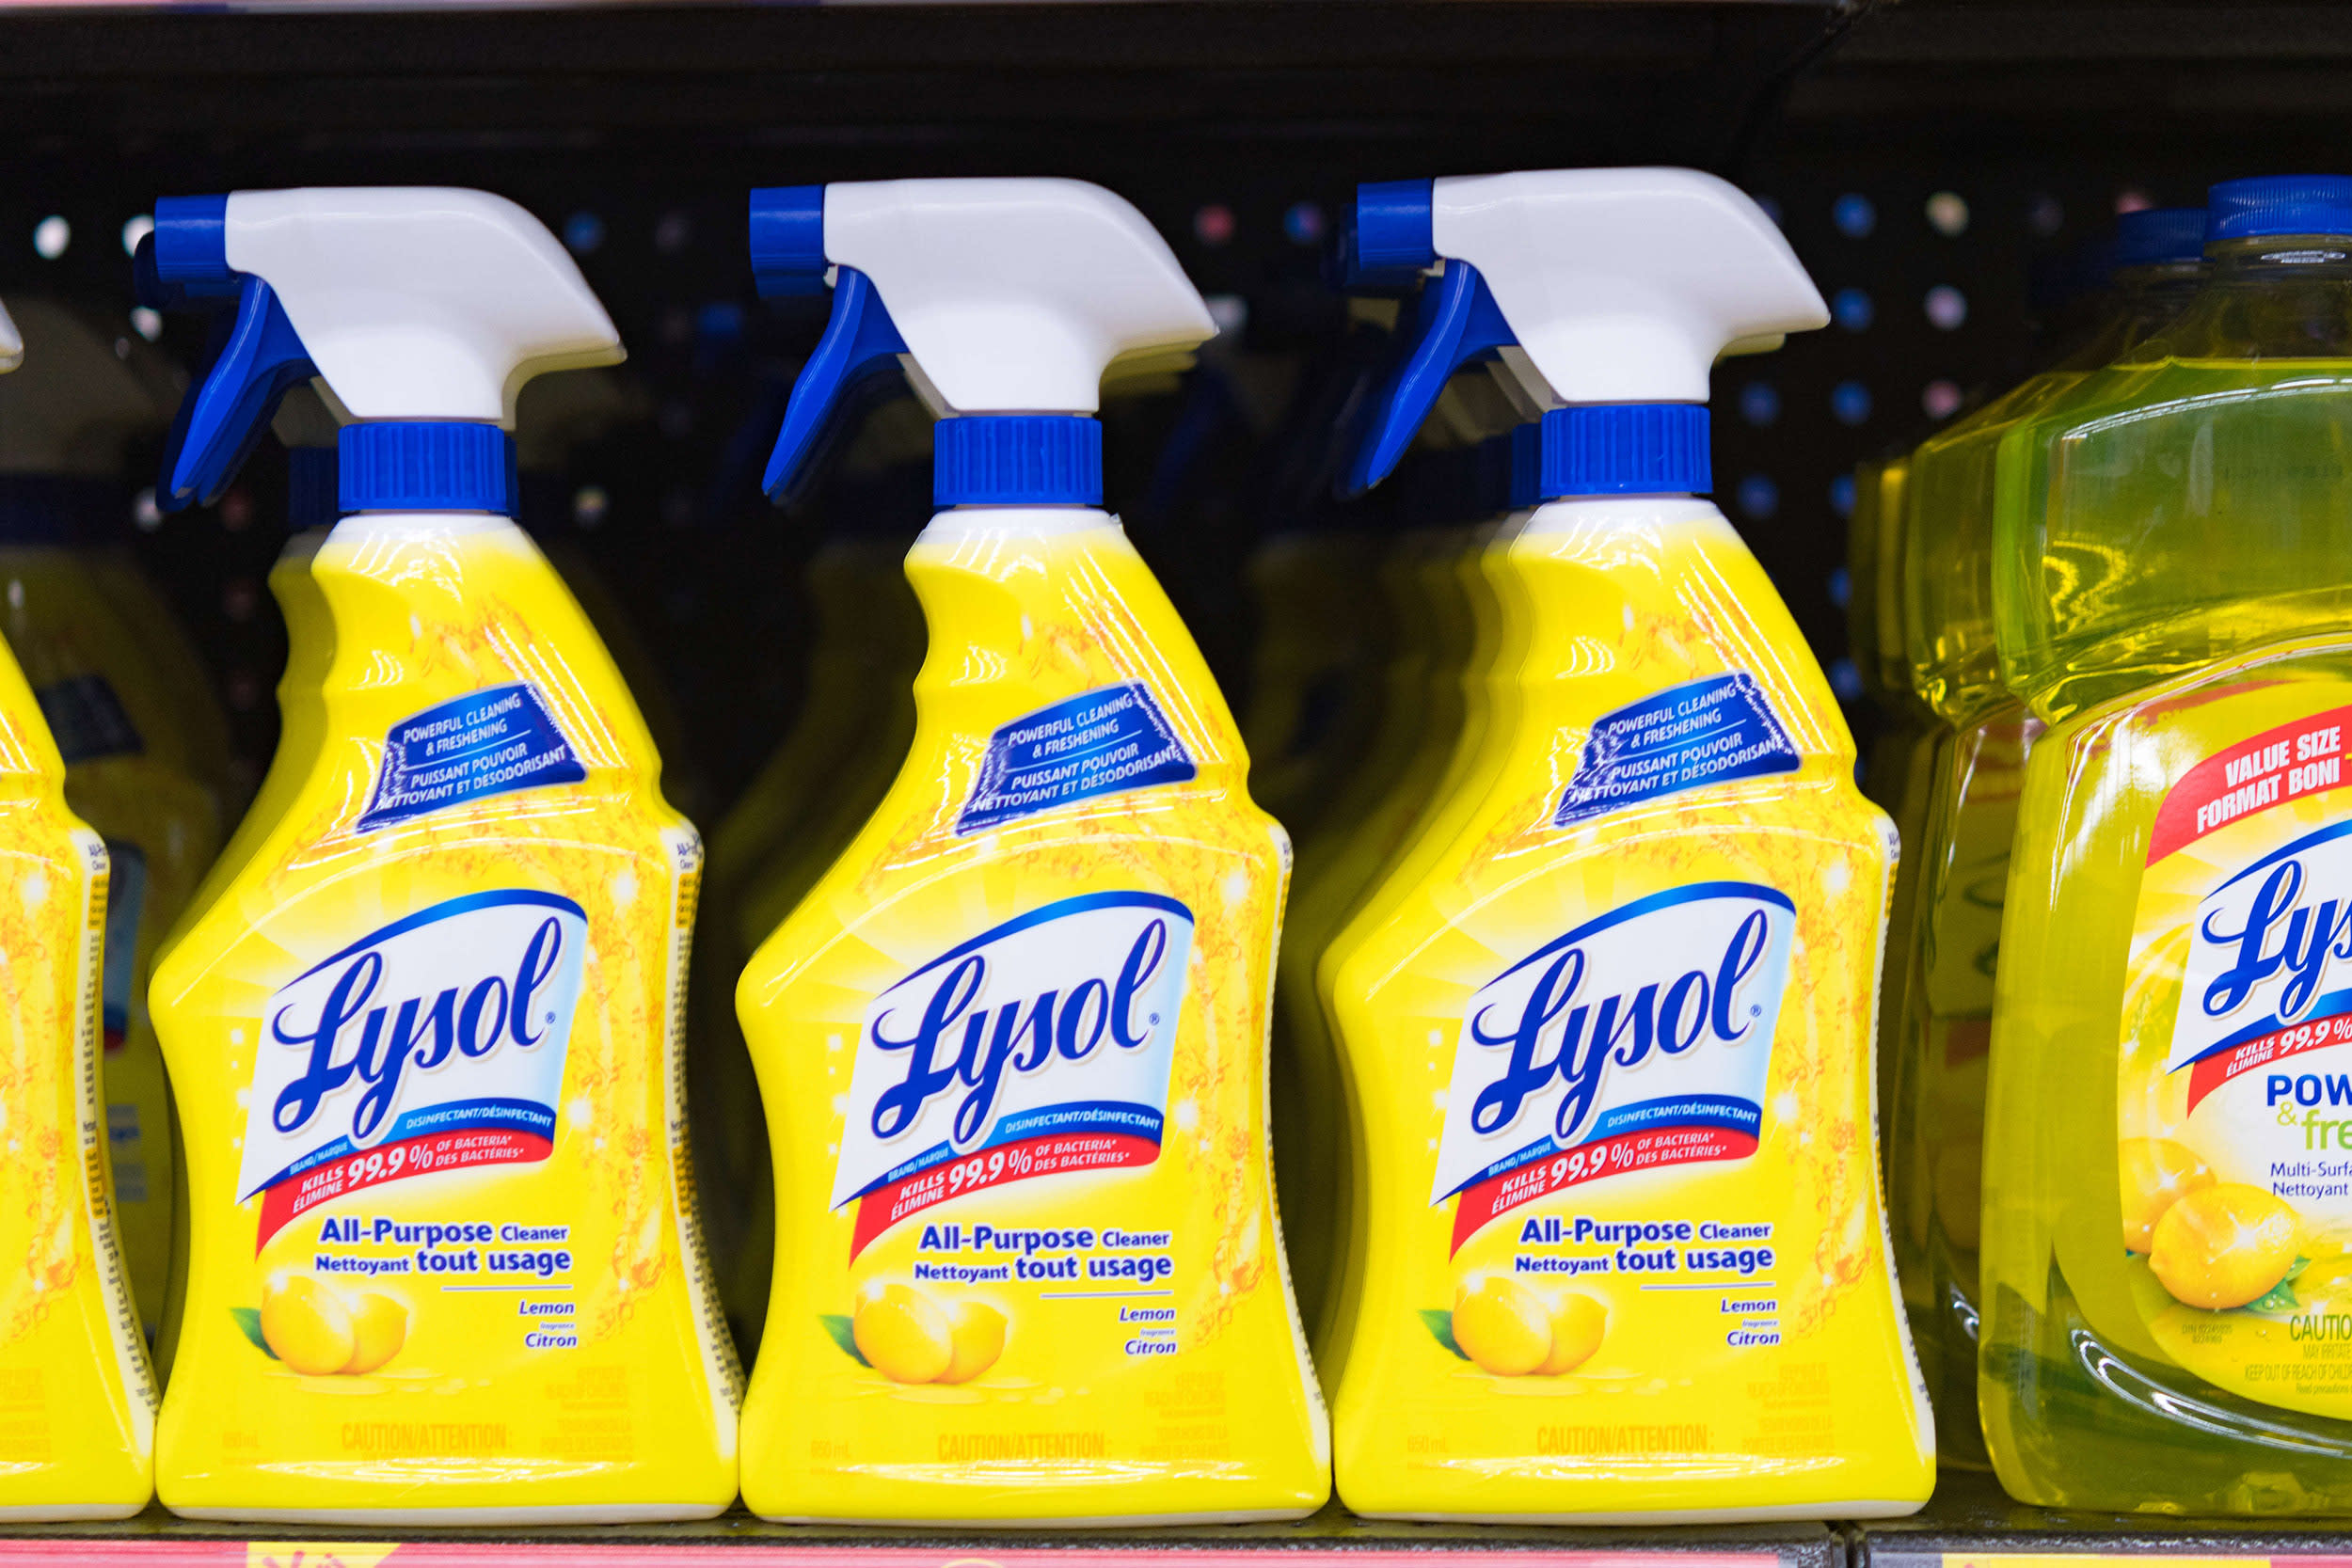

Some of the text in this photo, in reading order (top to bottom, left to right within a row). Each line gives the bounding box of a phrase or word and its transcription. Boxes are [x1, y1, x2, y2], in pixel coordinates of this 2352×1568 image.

[403, 692, 522, 744] POWERFUL CLEANING
[1008, 692, 1133, 747] POWERFUL CLEANING
[1607, 682, 1737, 736] POWERFUL CLEANING
[1630, 707, 1723, 749] & FRESHENING
[425, 718, 508, 756] & FRESHENING
[1032, 718, 1120, 759] & FRESHENING
[1610, 732, 1743, 779] PUISSANT POUVOIR
[2224, 725, 2342, 788] VALUE SIZE
[375, 743, 567, 812] NETTOYANT ET DÉSODORISANT
[410, 741, 528, 789] PUISSANT POUVOIR
[970, 744, 1181, 813] NETTOYANT ET DÉSODORISANT
[1010, 742, 1139, 791] PUISSANT POUVOIR
[1661, 769, 1677, 786] ET
[1680, 735, 1784, 783] DÉSODORISANT
[2197, 756, 2341, 834] FORMAT BONI
[272, 915, 563, 1140] Lysol
[870, 918, 1167, 1146] Lysol
[1470, 909, 1769, 1140] Lysol
[2234, 1036, 2276, 1061] KILLS
[2280, 1021, 2331, 1055] 99.9
[2226, 1047, 2274, 1078] ÉLIMINE
[2267, 1073, 2352, 1107] POW
[405, 1103, 553, 1131] DISINFECTANT/DÉSINFECTANT
[1005, 1107, 1160, 1134] DISINFECTANT/DÉSINFECTANT
[1607, 1101, 1758, 1129] DISINFECTANT/DÉSINFECTANT
[2276, 1101, 2298, 1127] &
[293, 1179, 343, 1214] ÉLIMINE
[435, 1152, 457, 1167] DES
[301, 1164, 344, 1195] KILLS
[347, 1146, 405, 1187] 99.9
[409, 1143, 435, 1170] %
[436, 1138, 453, 1153] OF
[899, 1170, 946, 1200] KILLS
[948, 1150, 1006, 1195] 99.9
[1008, 1147, 1033, 1175] %
[1034, 1142, 1052, 1157] OF
[1491, 1179, 1546, 1215] ÉLIMINE
[1635, 1150, 1659, 1165] DES
[1501, 1164, 1547, 1195] KILLS
[1550, 1145, 1607, 1188] 99.9
[1611, 1141, 1634, 1170] %
[1636, 1135, 1653, 1150] OF
[890, 1187, 945, 1222] ÉLIMINE
[1034, 1156, 1058, 1172] DES
[2272, 1180, 2349, 1200] Nettoyant
[320, 1217, 568, 1249] All-Purpose Cleaner
[919, 1225, 1170, 1256] All-Purpose Cleaner
[1520, 1218, 1772, 1247] All-Purpose Cleaner
[315, 1249, 571, 1276] Nettoyant tout usage
[914, 1256, 1172, 1283] Nettoyant tout usage
[1515, 1248, 1773, 1275] Nettoyant tout usage
[518, 1300, 575, 1315] Lemon
[1119, 1307, 1176, 1322] Lemon
[1720, 1298, 1777, 1313] Lemon
[524, 1333, 578, 1348] Citron
[1124, 1339, 1177, 1355] Citron
[1726, 1330, 1781, 1346] Citron
